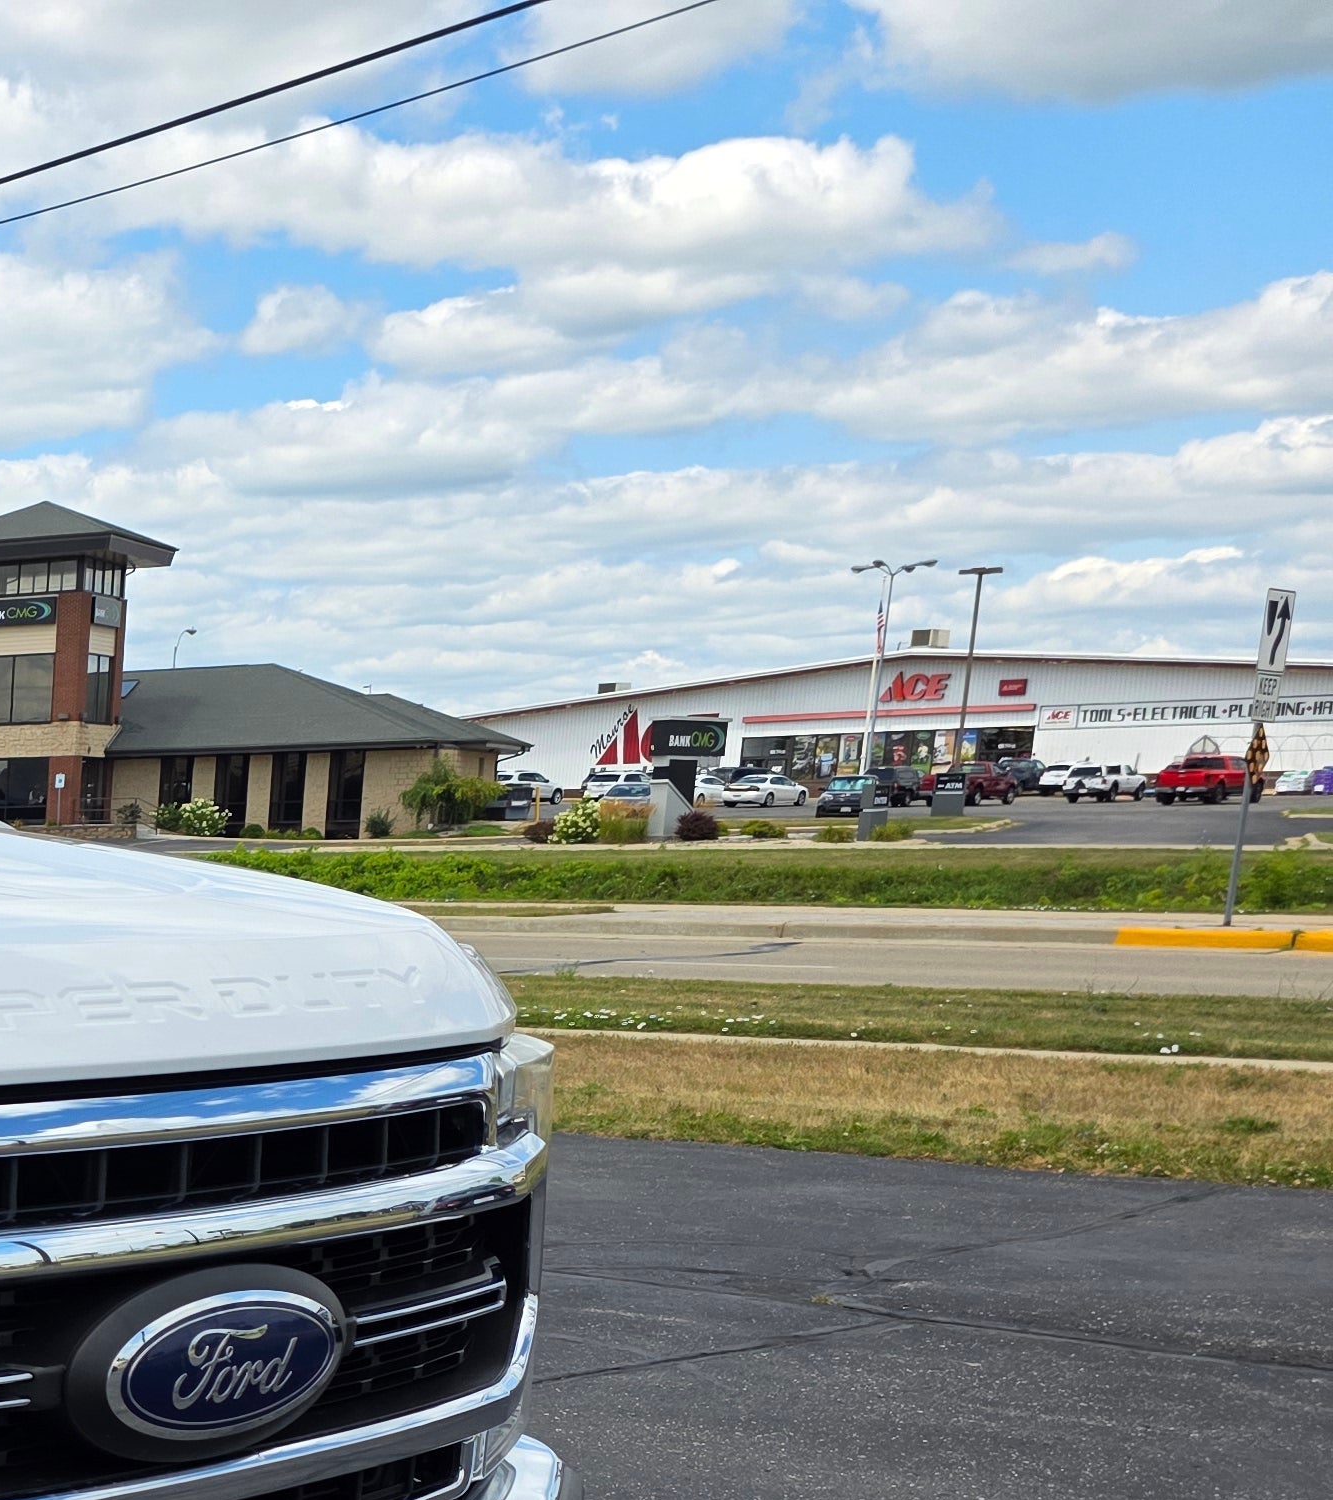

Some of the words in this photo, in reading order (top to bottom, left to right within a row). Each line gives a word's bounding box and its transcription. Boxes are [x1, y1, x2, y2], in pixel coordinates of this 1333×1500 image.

[6, 606, 37, 619] CMG
[879, 671, 951, 702] ACE
[1258, 678, 1278, 696] KEEP
[1047, 709, 1072, 720] ACE
[1082, 708, 1126, 723] TOOLS
[1133, 705, 1221, 721] ELECTRICAL
[590, 703, 634, 758] Monroe
[669, 734, 691, 747] BANK
[691, 731, 715, 748] CMG
[944, 782, 963, 790] ATM
[208, 964, 428, 1020] DUTY
[172, 1323, 298, 1411] Ford
